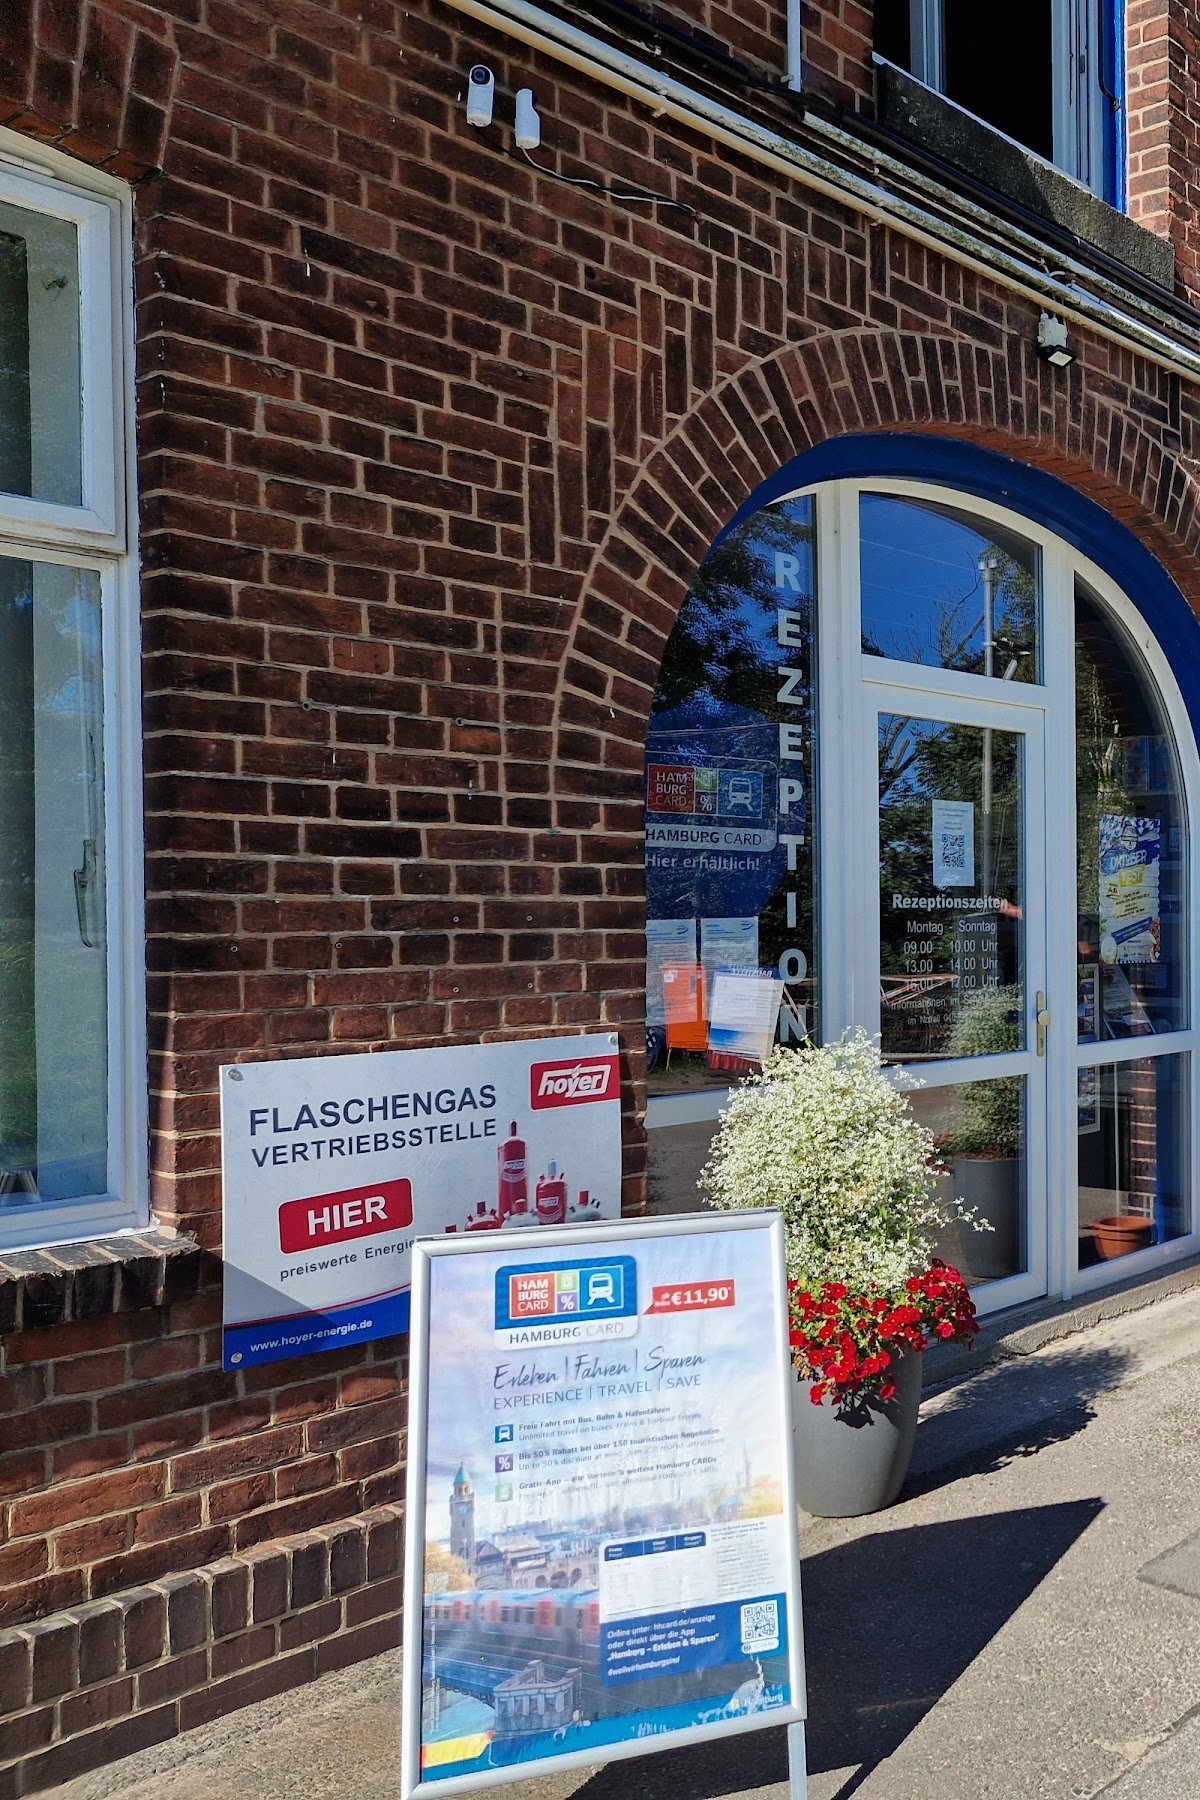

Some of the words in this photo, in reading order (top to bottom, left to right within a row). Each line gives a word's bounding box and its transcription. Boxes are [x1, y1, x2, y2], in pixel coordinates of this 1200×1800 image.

[656, 772, 687, 783] HAM
[656, 783, 687, 795] BURG
[774, 552, 807, 1042] REZEPTION
[656, 795, 686, 806] CARD
[645, 829, 719, 843] HAMBURG
[724, 832, 762, 845] CARD
[645, 853, 677, 867] Hier
[683, 854, 760, 871] erhältlich!
[892, 893, 1009, 911] Rezeptionszeiten
[907, 921, 944, 935] Montag
[958, 920, 996, 934] Sonntag
[904, 941, 933, 954] 09.00
[949, 940, 976, 953] 10.00
[981, 939, 998, 952] Uhr
[904, 959, 933, 973] 13.00
[949, 957, 976, 971] 14.00
[981, 957, 998, 970] Uhr
[981, 975, 999, 988] Uhr
[538, 1067, 604, 1098] hoyer
[249, 1084, 497, 1136] FLASCHENGAS
[252, 1118, 497, 1168] VERTRIEBSSTELLE
[308, 1195, 388, 1236] HIER
[280, 1250, 358, 1281] preiswerte
[364, 1237, 415, 1260] Energie
[517, 1278, 549, 1291] HAM
[518, 1289, 549, 1301] BURG
[517, 1300, 549, 1312] CARD
[250, 1318, 373, 1353] www.hoyer-energie.de
[509, 1327, 581, 1344] HAMBURG
[586, 1322, 624, 1337] CARD
[493, 1362, 559, 1390] Erleben
[574, 1353, 630, 1382] Fahren
[644, 1345, 706, 1380] Sparen
[494, 1388, 583, 1409] EXPERIENCE
[599, 1380, 652, 1398] TRAVEL
[666, 1373, 702, 1389] SAVE
[519, 1423, 538, 1432] Freie
[540, 1420, 561, 1429] Fahrt
[596, 1413, 615, 1421] Bahn
[625, 1406, 671, 1418] Hafenfähren
[519, 1430, 555, 1441] Unlimited
[557, 1428, 579, 1438] travel
[519, 1452, 531, 1460] Bis
[552, 1446, 578, 1456] Rabatt
[580, 1444, 592, 1452] bei
[593, 1441, 610, 1450] über
[613, 1439, 628, 1448] 150
[519, 1463, 530, 1471] Up
[532, 1461, 541, 1469] to
[656, 1461, 690, 1472] Hamburg
[692, 1456, 717, 1465] CARDs
[607, 1628, 630, 1639] Online
[654, 1614, 716, 1631] hhcard.de/anzeige
[607, 1641, 625, 1650] oder
[626, 1636, 648, 1647] direkt
[650, 1633, 666, 1643] über
[668, 1629, 680, 1638] die
[681, 1627, 695, 1638] App
